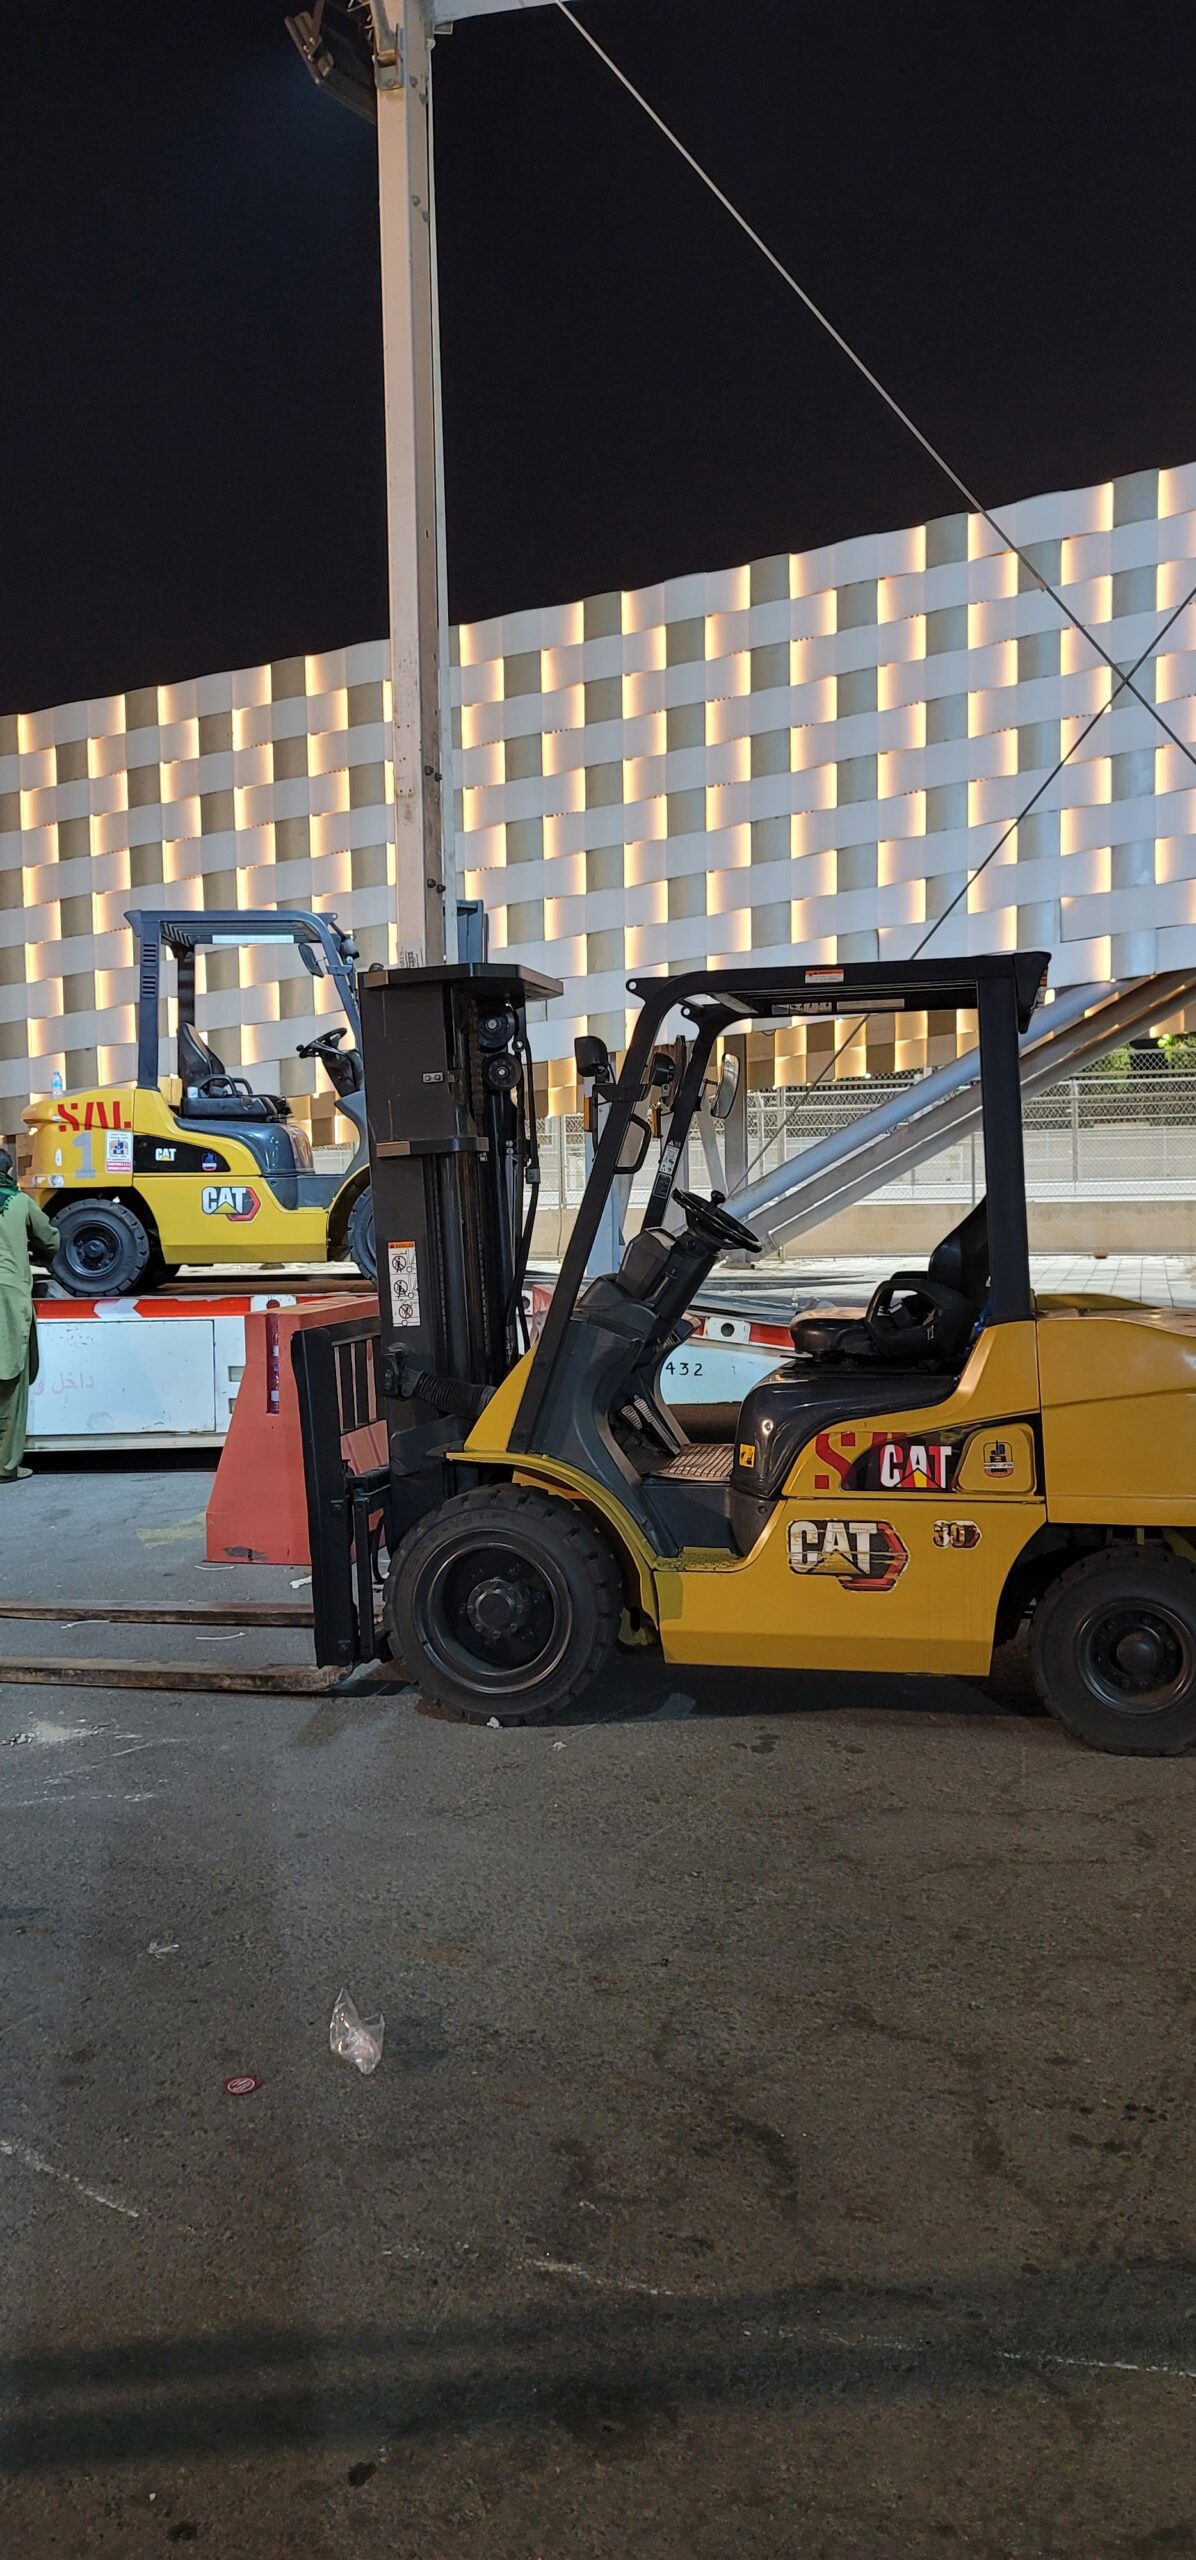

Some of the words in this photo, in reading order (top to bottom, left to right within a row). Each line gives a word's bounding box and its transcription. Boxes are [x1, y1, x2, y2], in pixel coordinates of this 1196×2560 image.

[73, 1131, 97, 1178] 1
[155, 1148, 176, 1161] CAT
[202, 1187, 246, 1214] CAT
[665, 1361, 703, 1377] 432
[880, 1444, 952, 1489] CAT
[789, 1521, 879, 1575] CAT
